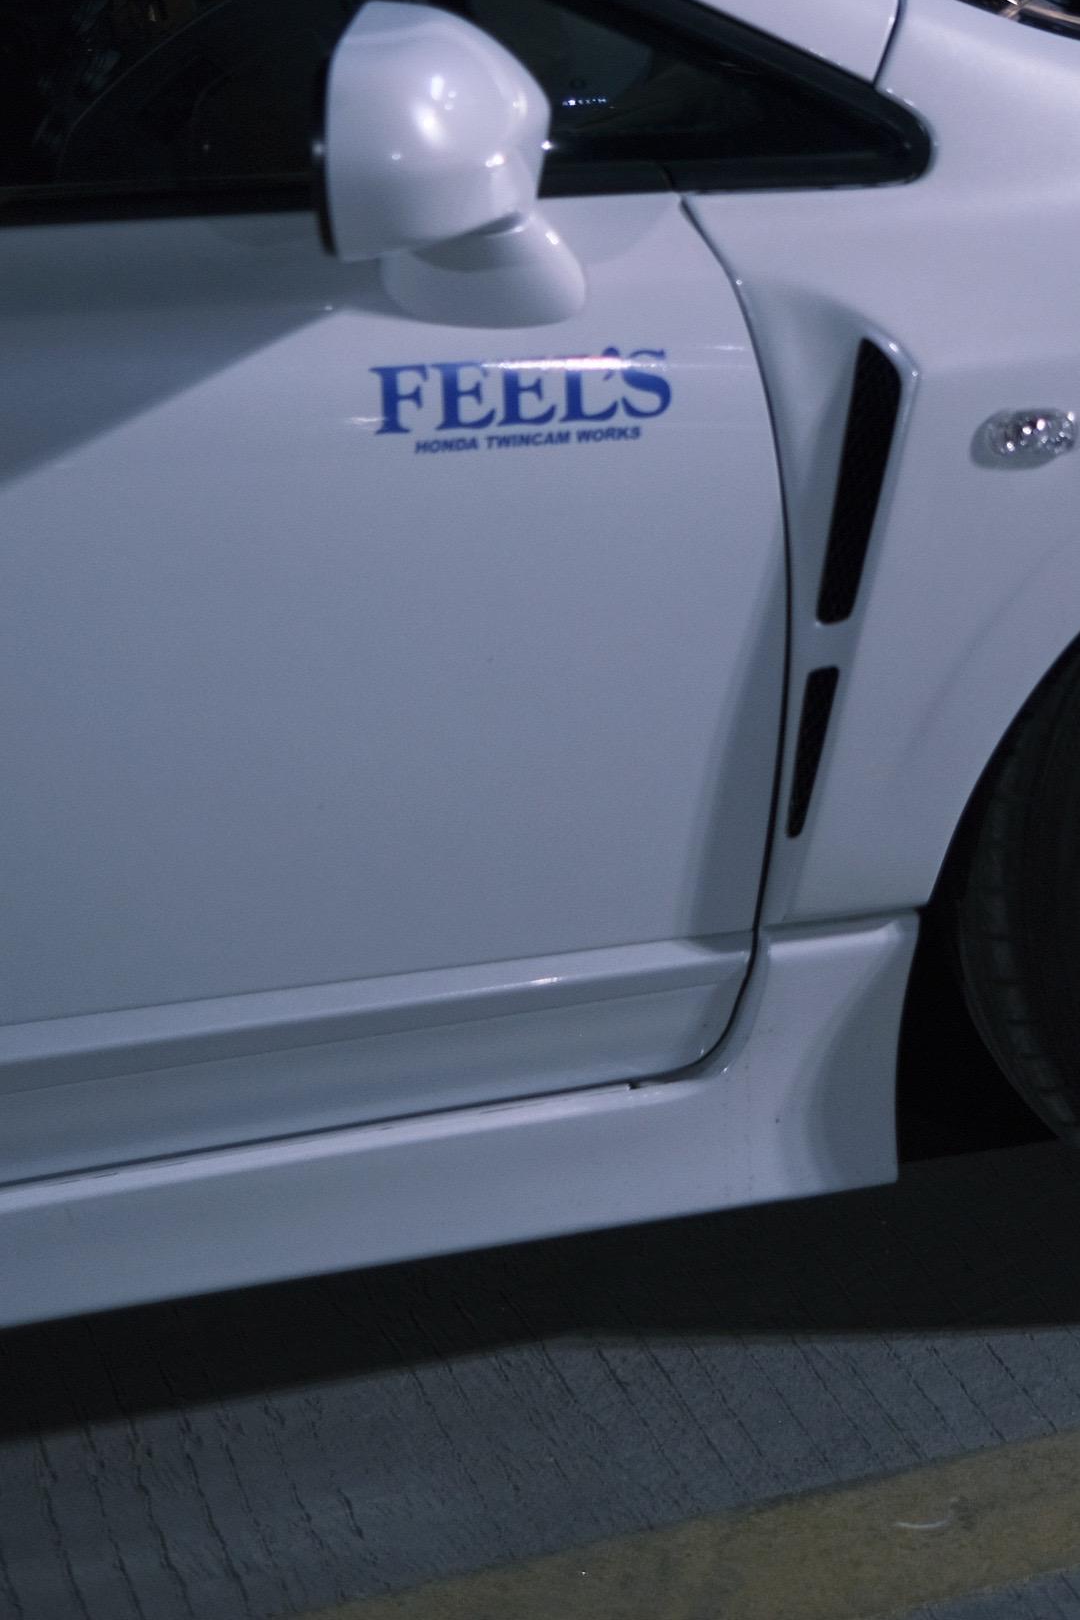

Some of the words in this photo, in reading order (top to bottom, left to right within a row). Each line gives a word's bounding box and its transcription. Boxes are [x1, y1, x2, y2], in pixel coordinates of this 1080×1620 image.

[415, 437, 479, 454] HONDA
[486, 431, 570, 450] TWINCAM
[577, 426, 641, 443] WORKS
